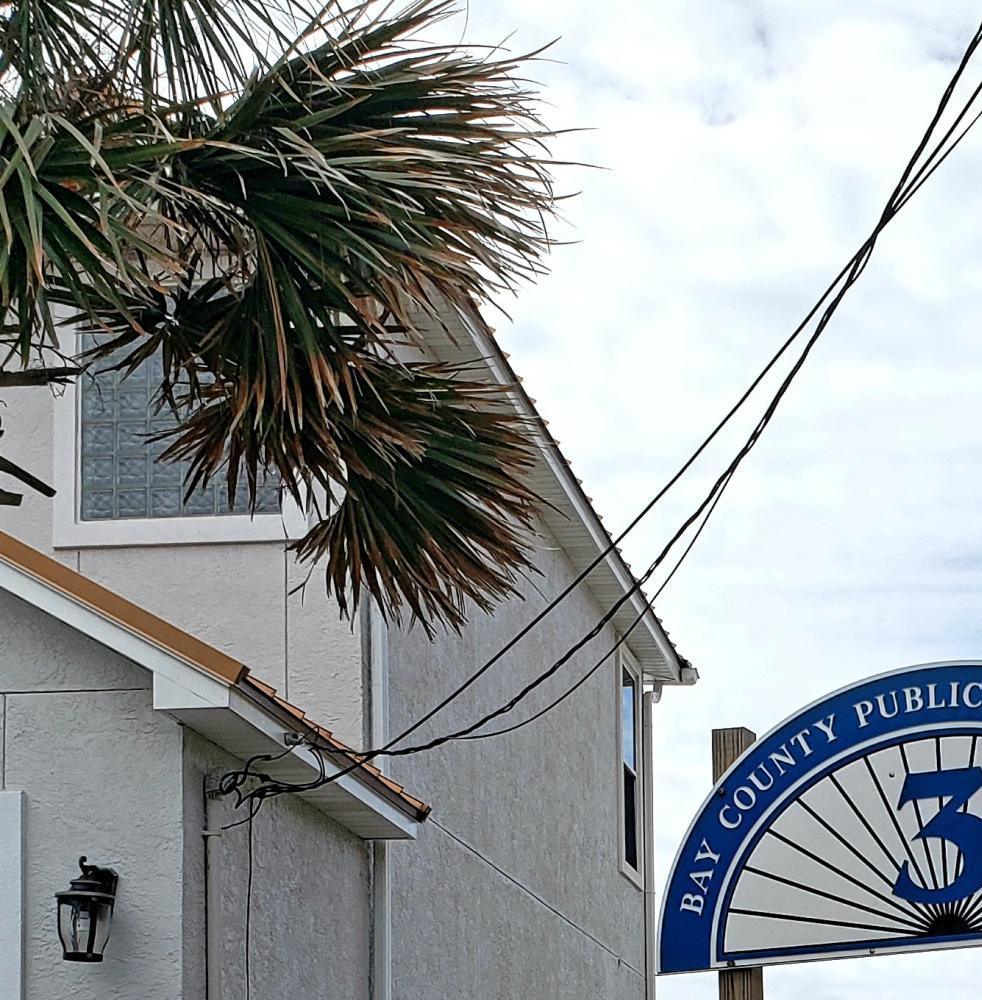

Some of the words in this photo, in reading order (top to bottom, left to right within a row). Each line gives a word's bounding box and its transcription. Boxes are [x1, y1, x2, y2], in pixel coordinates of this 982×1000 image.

[680, 838, 720, 916] BAY
[718, 713, 837, 829] COUNTY
[853, 682, 982, 728] PUBLIC
